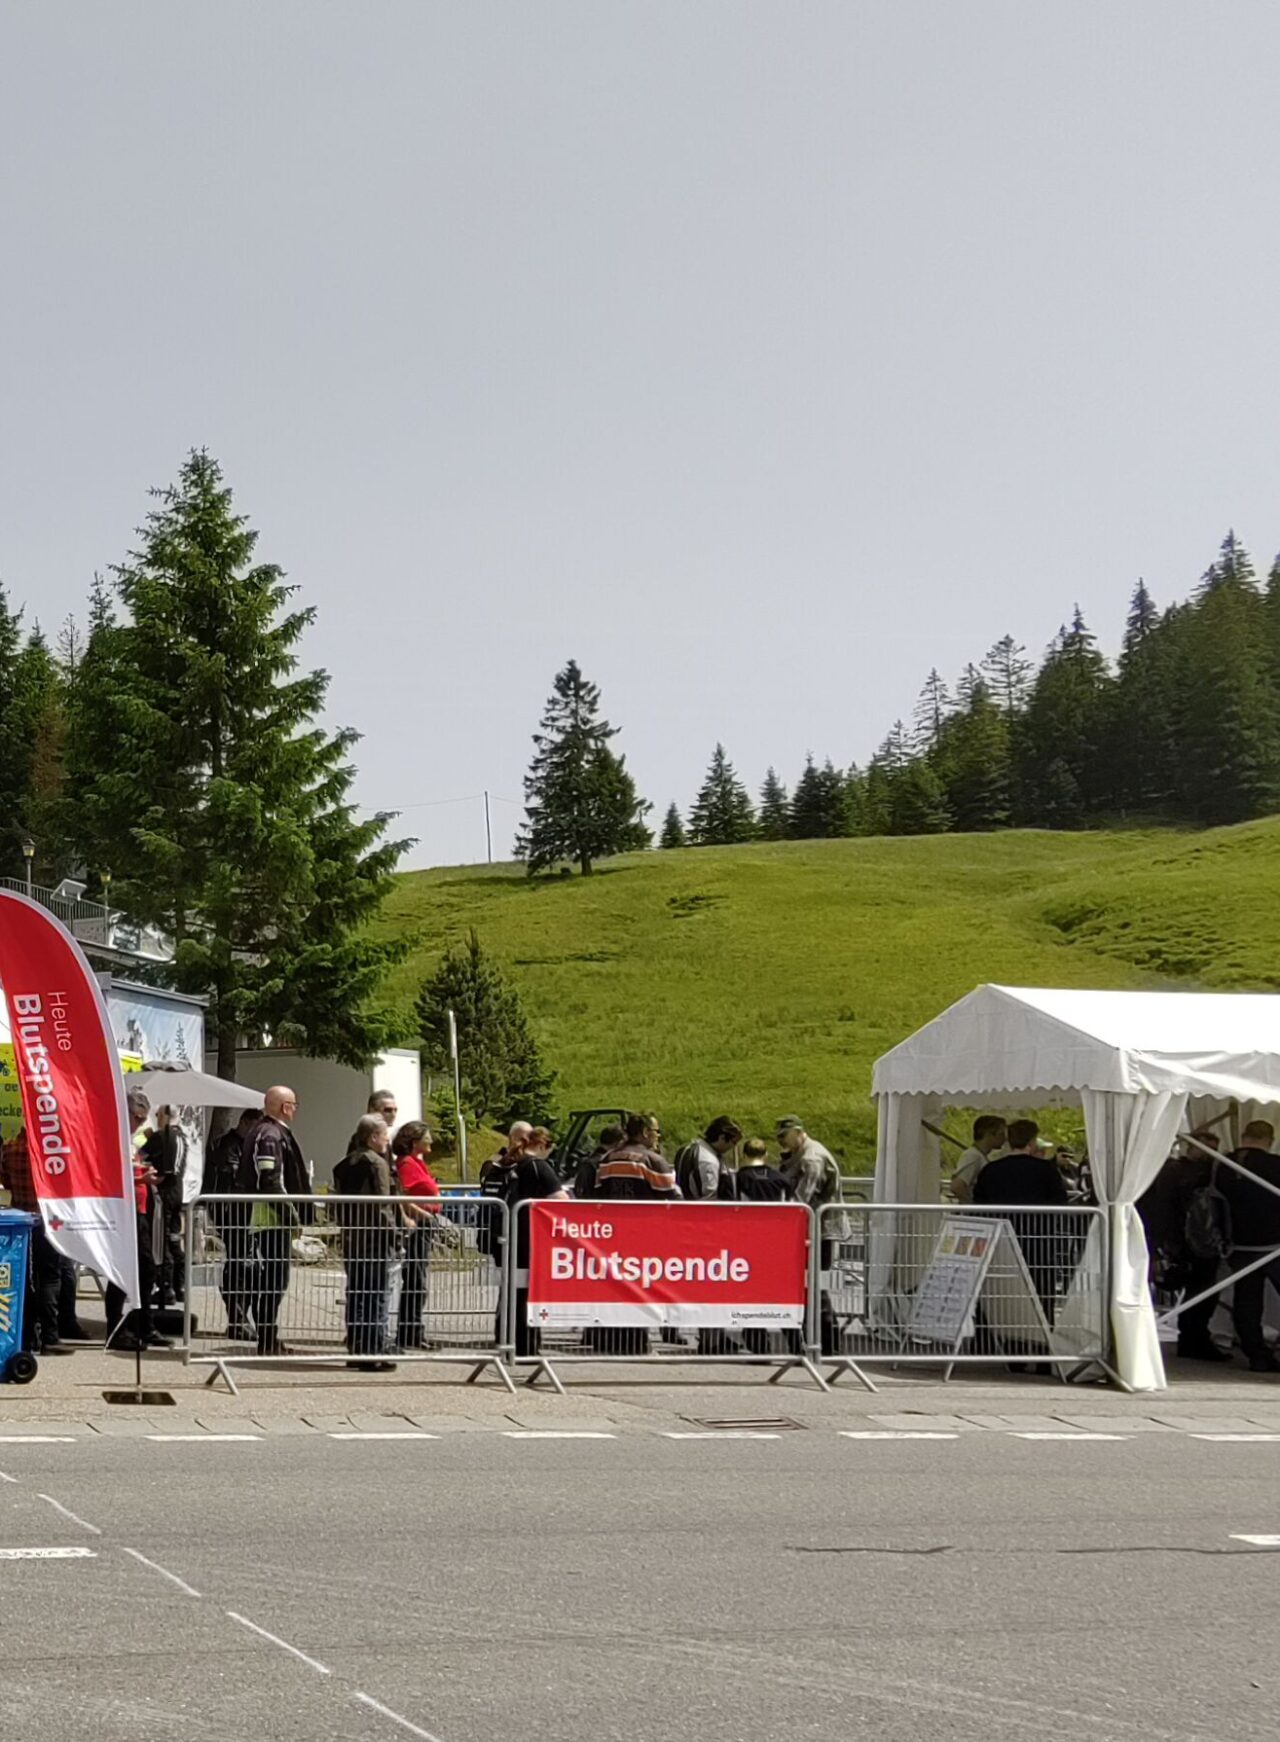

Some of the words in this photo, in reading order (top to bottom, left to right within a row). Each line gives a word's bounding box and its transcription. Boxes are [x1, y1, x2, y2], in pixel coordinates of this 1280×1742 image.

[48, 991, 72, 1051] Heute
[13, 993, 71, 1176] Blutspende
[551, 1218, 613, 1239] Heute
[551, 1247, 749, 1288] Blutspende
